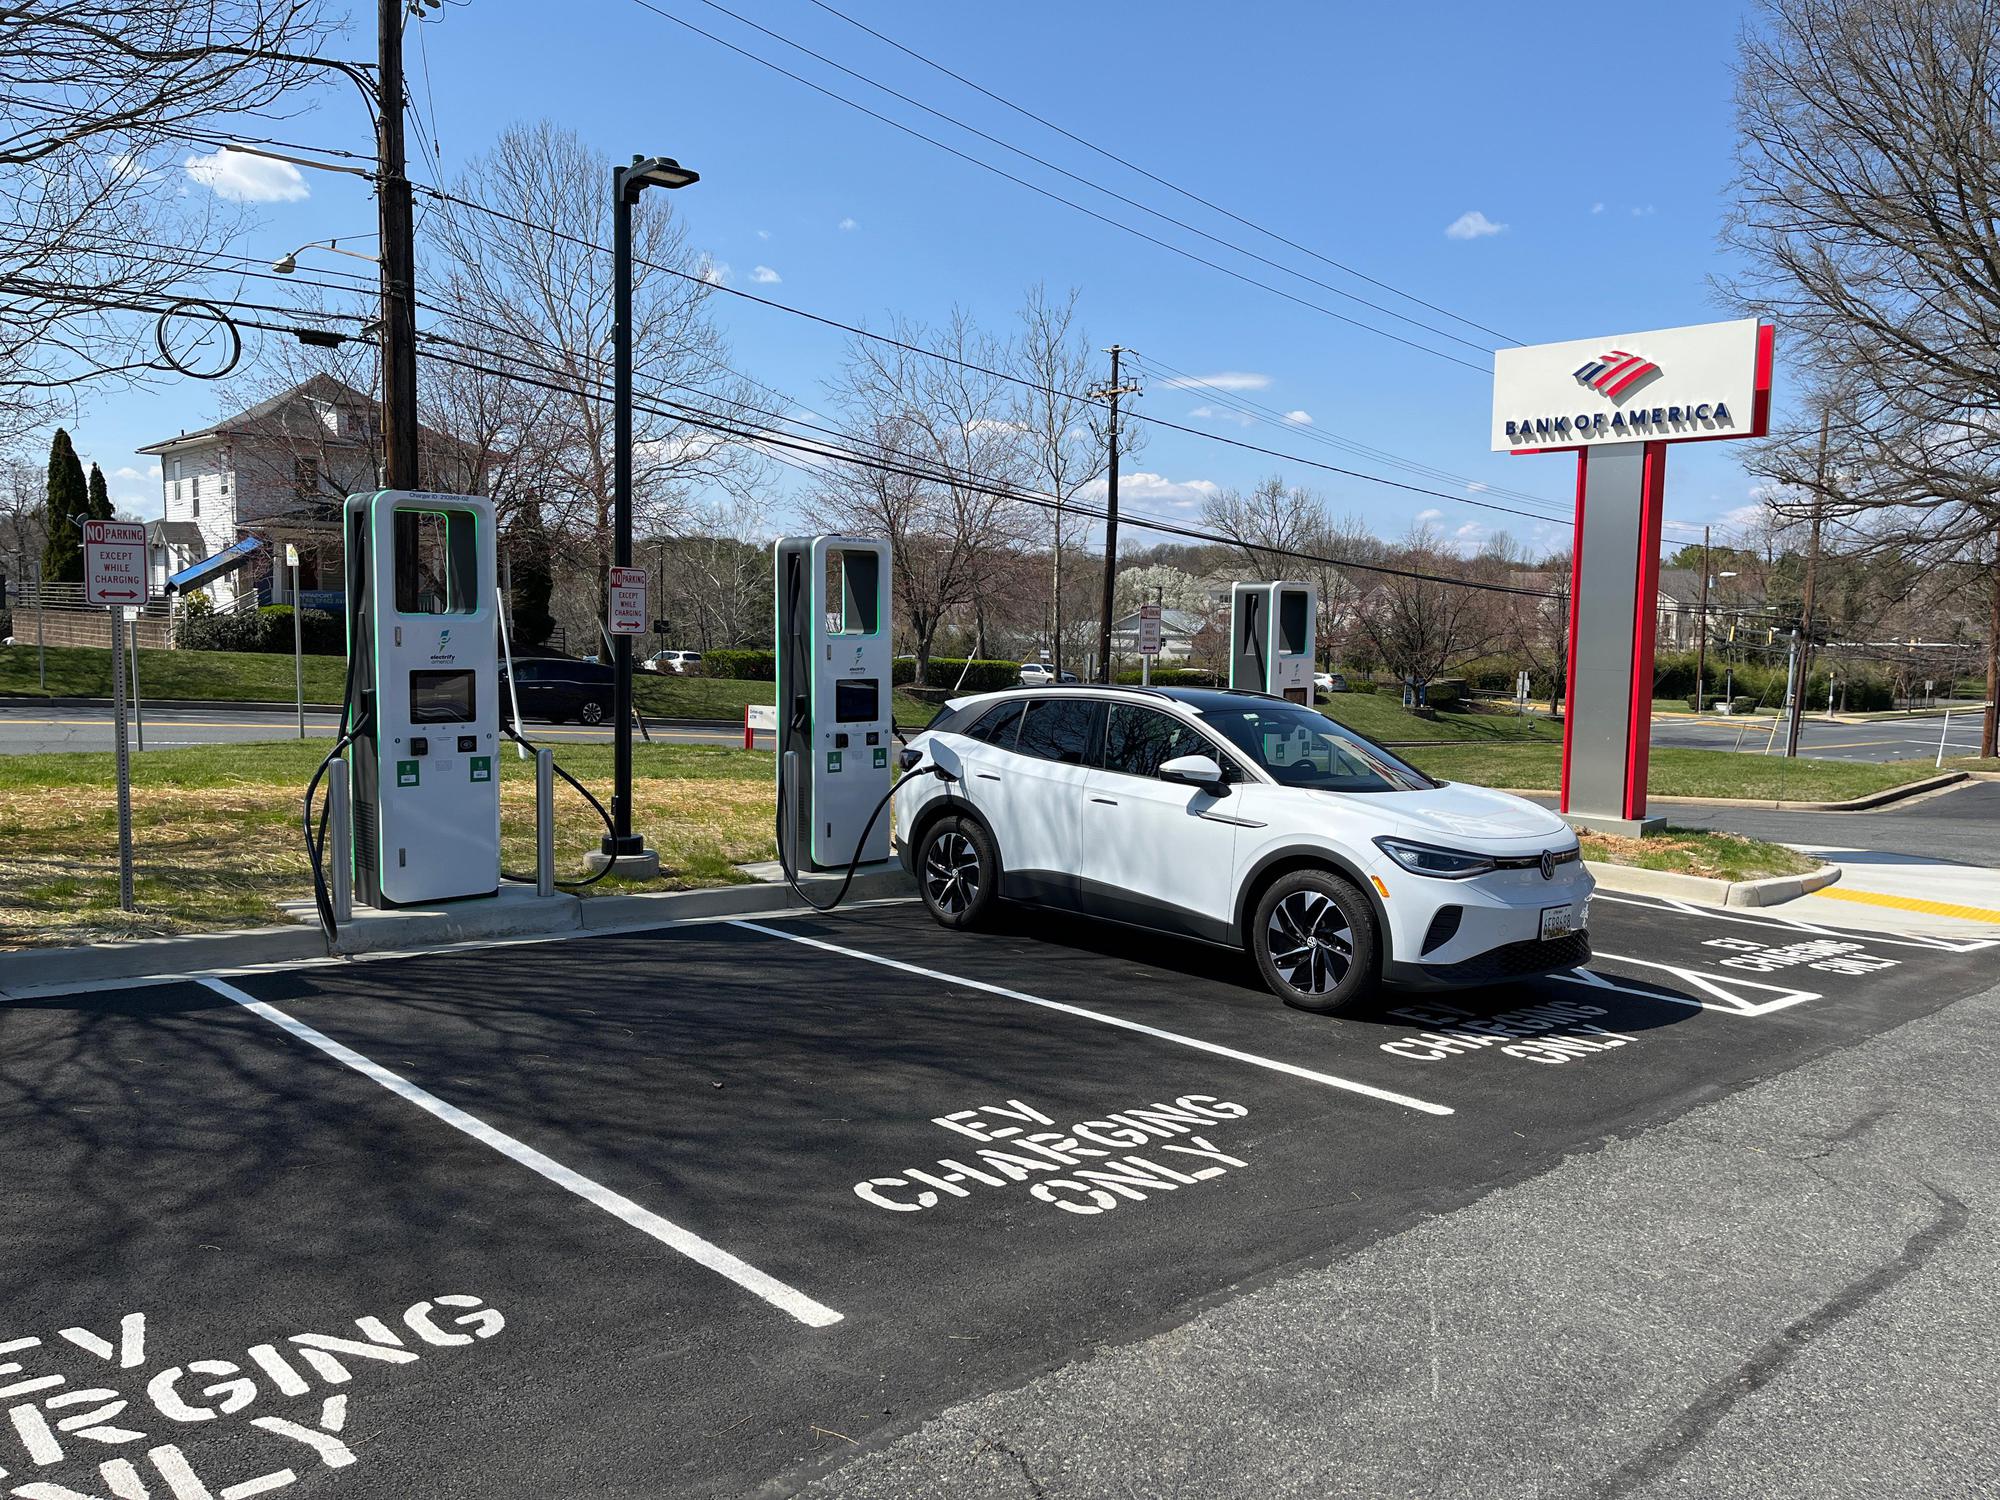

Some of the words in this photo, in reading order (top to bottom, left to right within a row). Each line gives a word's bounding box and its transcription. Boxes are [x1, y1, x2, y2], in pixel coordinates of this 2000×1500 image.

[1505, 416, 1566, 436] BANK
[1574, 412, 1604, 431] OF
[1610, 402, 1729, 427] AMERICA
[86, 525, 104, 542] NO
[105, 528, 143, 541] PARKING
[100, 551, 133, 561] EXCEPT
[104, 564, 130, 572] WHILE
[95, 575, 140, 584] CHARGING
[611, 571, 622, 585] NO
[622, 574, 644, 584] PARKING
[618, 591, 639, 599] EXCEPT
[1700, 937, 1770, 952] EV
[1719, 939, 1866, 972] CHARGING
[1807, 952, 1903, 976] ONLY
[1386, 1001, 1477, 1025] EV
[1379, 1000, 1609, 1061] CHARGING
[1500, 1023, 1639, 1064] ONLY
[931, 1099, 1055, 1142] EV
[853, 1094, 1249, 1212] CHARGING
[1030, 1136, 1250, 1215] ONLY
[0, 1294, 506, 1479] RGING
